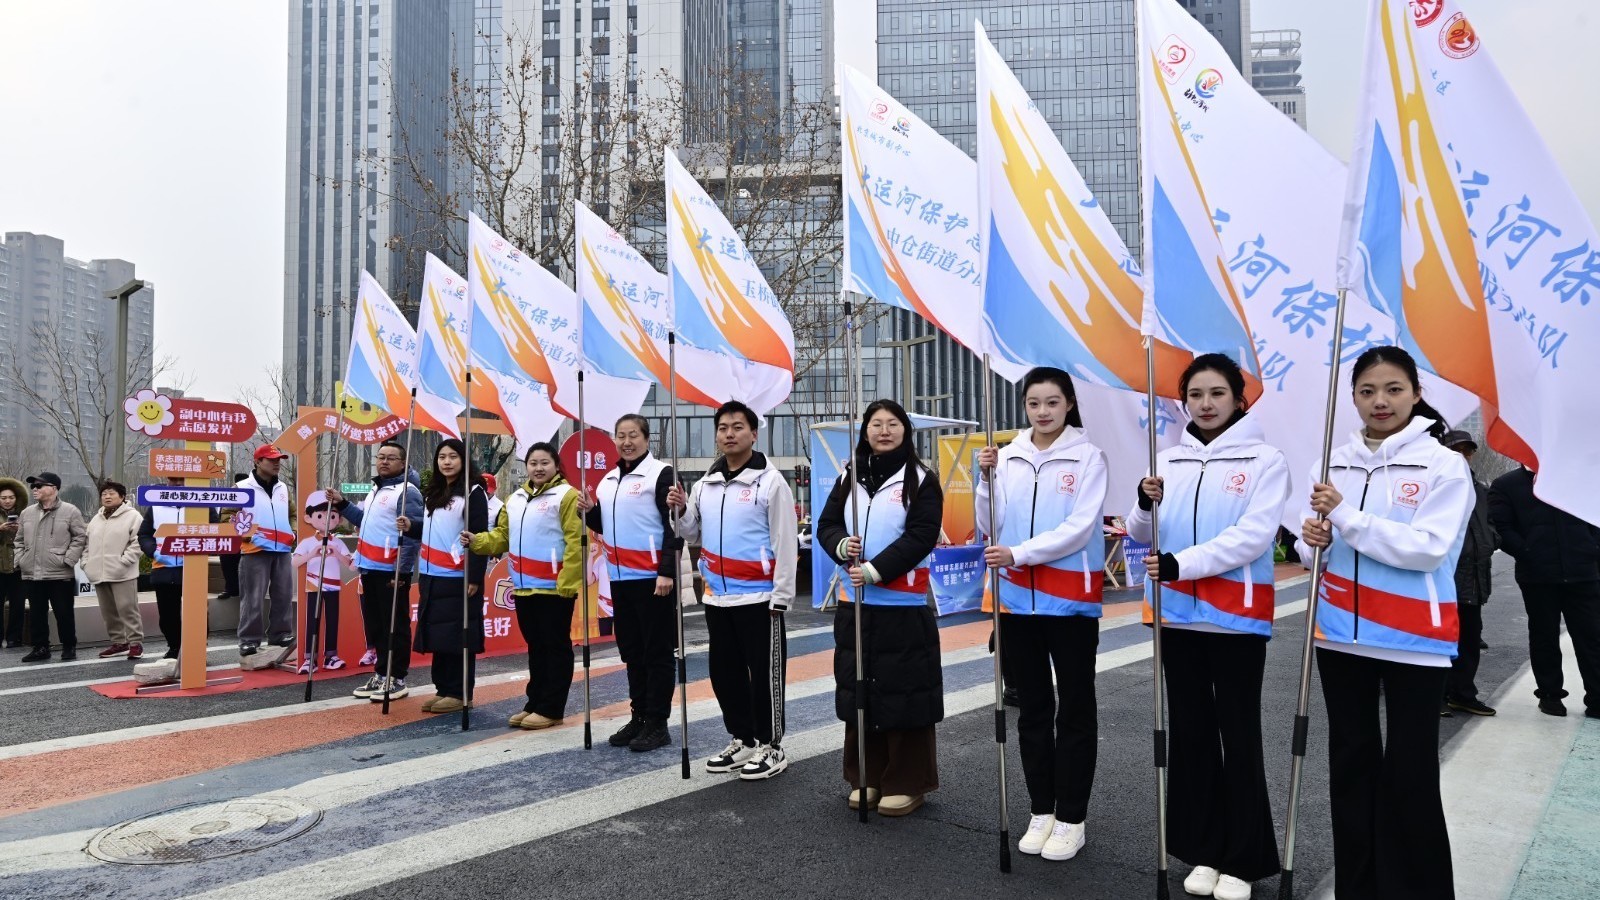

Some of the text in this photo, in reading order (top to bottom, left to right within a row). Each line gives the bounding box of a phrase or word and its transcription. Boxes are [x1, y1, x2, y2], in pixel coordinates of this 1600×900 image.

[179, 408, 247, 424] 副中心有我
[178, 421, 233, 436] 志愿发光
[155, 454, 202, 464] 承志愿初心
[155, 463, 203, 473] 守城市温暖
[177, 525, 219, 535] 牵手志愿
[169, 538, 233, 553] 点亮通州
